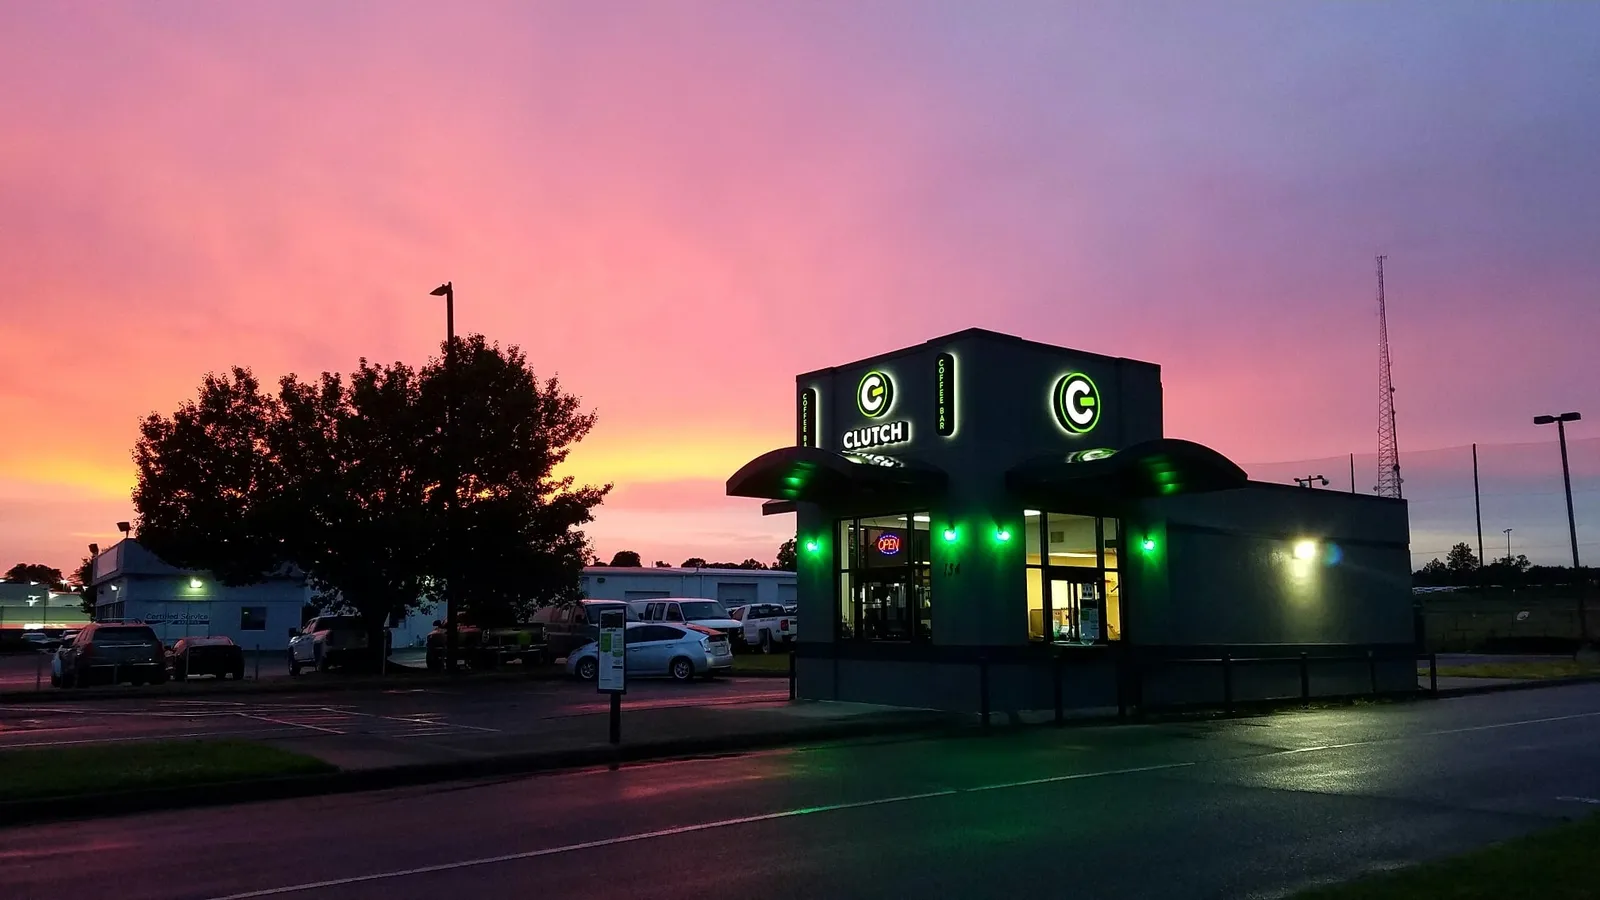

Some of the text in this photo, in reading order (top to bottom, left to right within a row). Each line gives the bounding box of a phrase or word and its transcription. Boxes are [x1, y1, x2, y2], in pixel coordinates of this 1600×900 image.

[843, 422, 902, 449] CLUTCH
[878, 538, 900, 551] OPEN
[181, 612, 209, 620] Service
